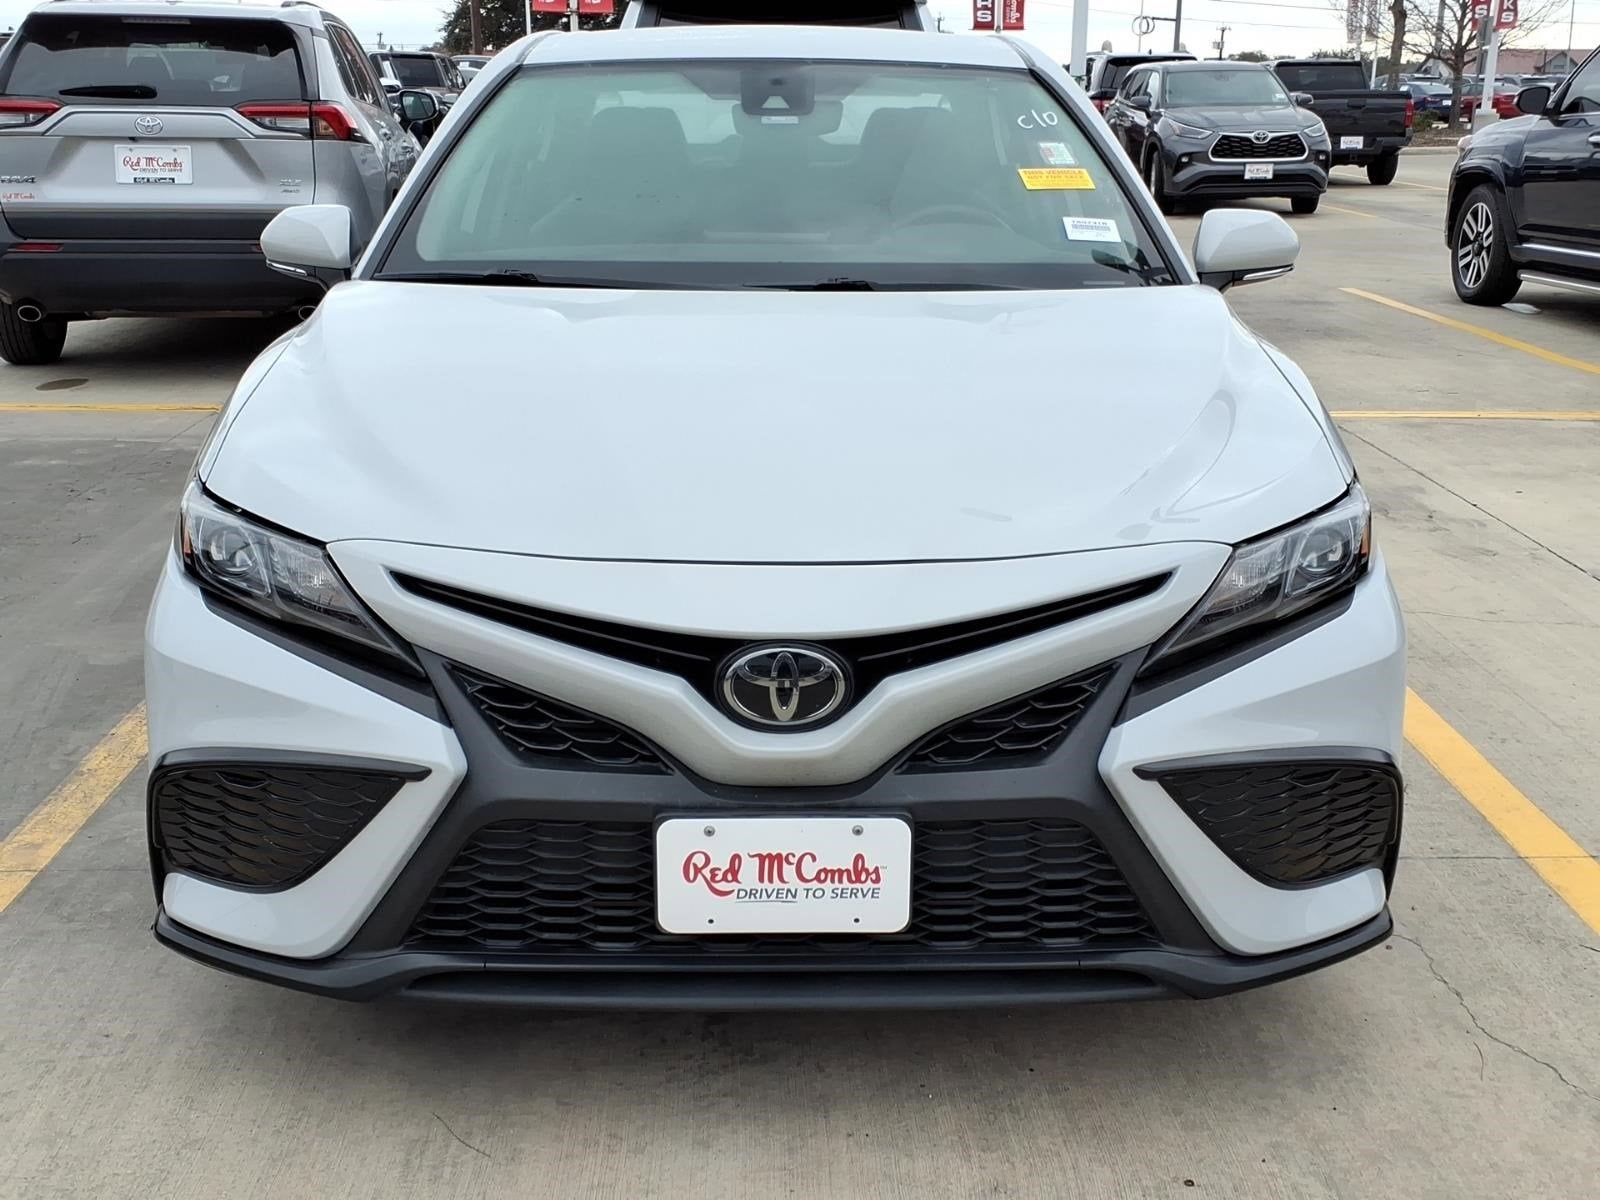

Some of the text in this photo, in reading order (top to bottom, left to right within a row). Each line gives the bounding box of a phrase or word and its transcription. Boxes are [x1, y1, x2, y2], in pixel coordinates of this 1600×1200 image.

[122, 155, 141, 171] Red
[682, 850, 881, 897] Red McCombs
[736, 887, 881, 900] DRIVEN TO SERVE
